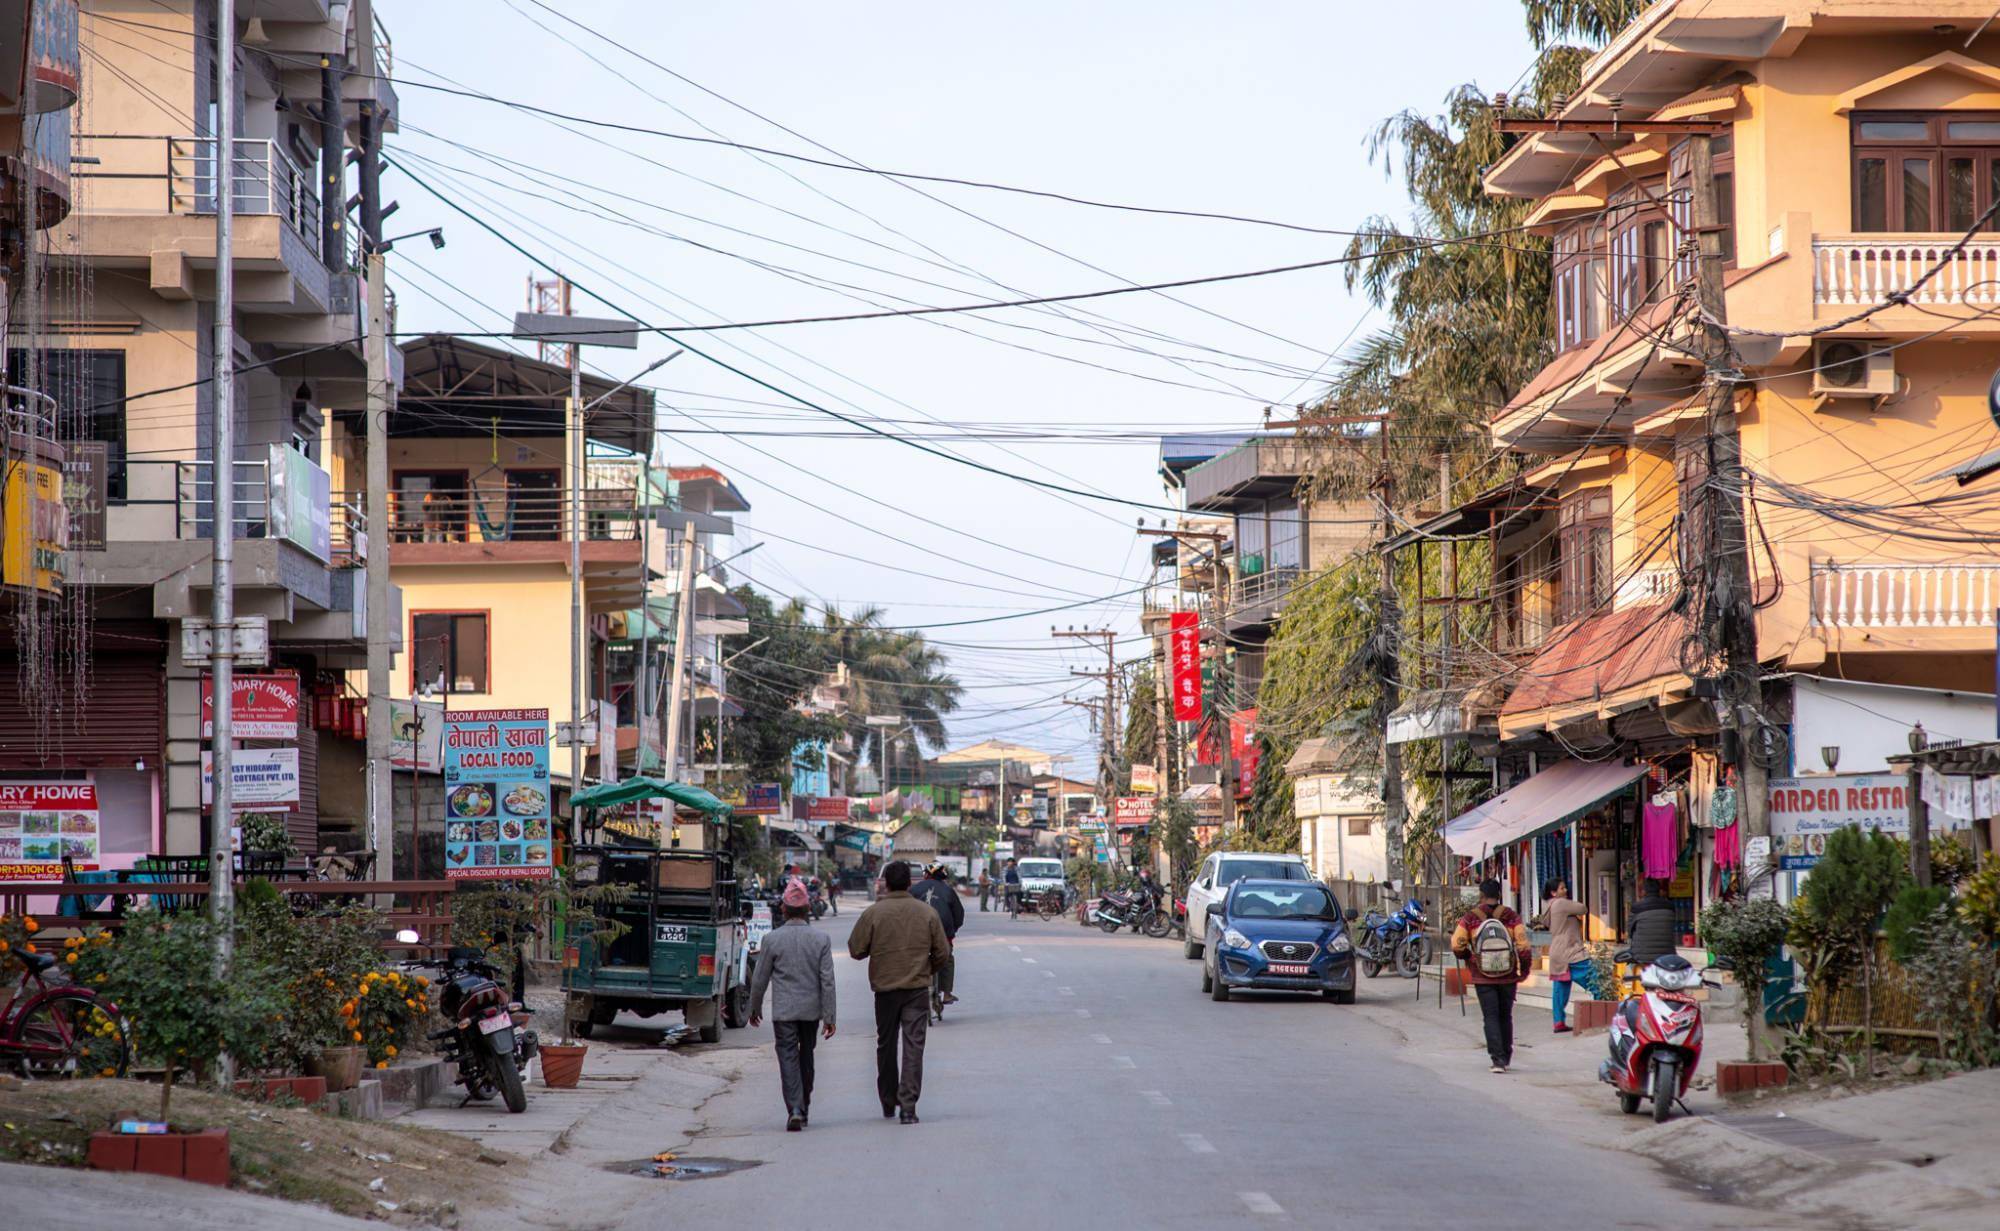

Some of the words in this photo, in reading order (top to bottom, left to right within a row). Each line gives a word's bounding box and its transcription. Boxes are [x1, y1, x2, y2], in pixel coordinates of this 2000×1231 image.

[265, 682, 298, 709] HOME
[446, 712, 474, 722] ROOM
[476, 710, 522, 721] AVAILABLE
[525, 709, 547, 720] HERE
[447, 723, 500, 749] नेपाली
[504, 727, 546, 748] खाना
[460, 752, 498, 768] LOCAL
[501, 751, 534, 767] FOOD
[245, 763, 282, 773] HIDEAWAY
[233, 773, 265, 783] COTTAGE
[0, 785, 28, 800] RY
[33, 785, 92, 800] HOME
[1847, 786, 1909, 811] RESTA
[1128, 800, 1154, 809] HOTEL
[0, 865, 45, 874] RMATION
[447, 870, 469, 878] SPECIAL
[470, 869, 498, 877] DISCOUNT
[499, 868, 510, 876] FOR
[511, 868, 530, 876] NEPALI
[530, 867, 550, 875] GROUP
